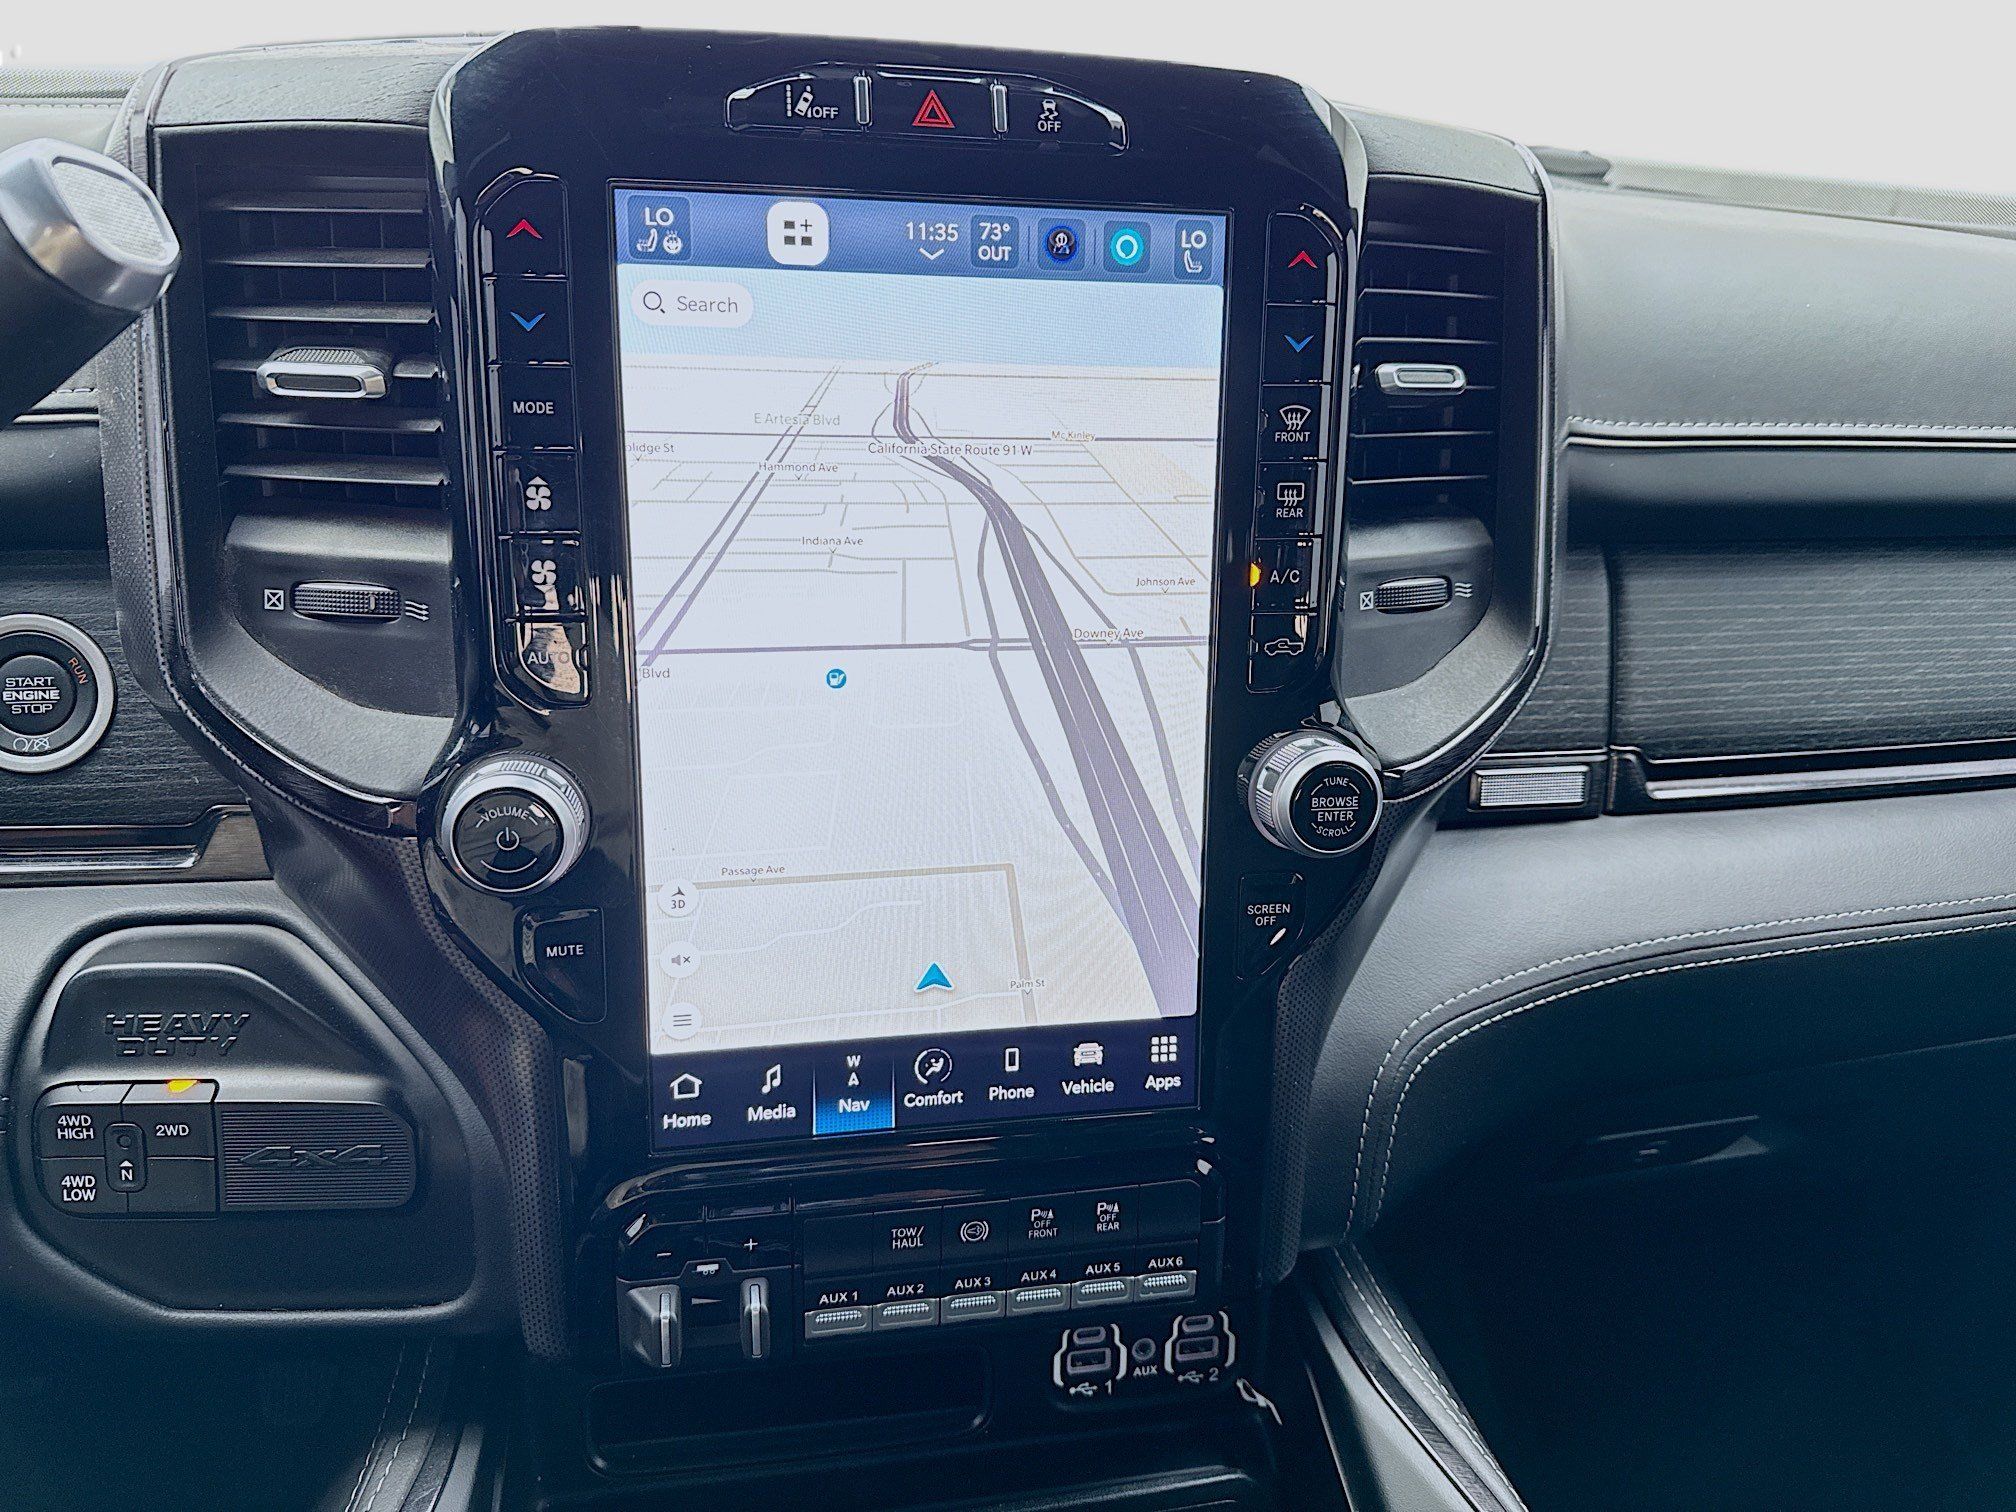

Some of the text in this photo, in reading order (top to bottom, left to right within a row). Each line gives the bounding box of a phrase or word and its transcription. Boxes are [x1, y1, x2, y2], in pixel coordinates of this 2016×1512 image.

[812, 106, 839, 119] OFF
[1037, 119, 1062, 132] OFF
[643, 207, 674, 227] LO
[905, 222, 959, 243] 11:35
[1181, 229, 1208, 249] LO
[978, 245, 1012, 262] OUT
[676, 295, 739, 315] Search
[512, 401, 555, 416] MODE
[754, 412, 841, 428] E Artesia Blvd
[1274, 430, 1311, 443] FRONT
[663, 442, 675, 453] St
[867, 441, 1033, 457] California State Route 91 W
[758, 460, 839, 473] Hammond Ave
[1275, 507, 1304, 520] REAR
[802, 534, 864, 547] Indiana Ave
[1136, 575, 1196, 588] Johnson Ave
[1269, 570, 1301, 585] A/C
[1074, 627, 1144, 641] Downey Ave
[68, 657, 89, 685] RUN
[642, 668, 671, 679] Blvd
[5, 676, 55, 687] START
[2, 690, 60, 700] ENGINE
[11, 704, 53, 714] STOP
[1323, 776, 1350, 788] TUNE
[1311, 795, 1359, 808] BROWSE
[481, 808, 530, 825] VOLUME
[1316, 809, 1354, 822] ENTER
[1316, 825, 1352, 838] SCROLL
[721, 863, 786, 878] Passage Ave
[670, 898, 686, 910] 3D
[1247, 904, 1291, 915] SCREEN
[1255, 916, 1277, 926] OFF
[546, 943, 585, 958] MUTE
[1010, 978, 1046, 989] Palm St
[106, 1013, 249, 1035] HEAVY
[115, 1037, 238, 1057] DUTY
[847, 1055, 861, 1068] W
[1062, 1078, 1114, 1095] Vehicle
[1145, 1073, 1181, 1093] Apps
[904, 1089, 963, 1108] Comfort
[989, 1083, 1034, 1102] Phone
[747, 1102, 796, 1121] Media
[838, 1097, 870, 1114] Nav
[57, 1115, 91, 1127] 4WD
[663, 1110, 711, 1129] Home
[57, 1127, 94, 1139] HIGH
[156, 1124, 189, 1137] 2WD
[122, 1168, 133, 1181] N
[61, 1176, 95, 1187] 4WD
[63, 1188, 96, 1201] LOW
[1034, 1220, 1051, 1229] OFF
[1099, 1214, 1117, 1223] OFF
[891, 1226, 924, 1239] TOW/
[1028, 1227, 1058, 1239] FRONT
[1097, 1221, 1120, 1232] REAR
[892, 1237, 923, 1249] HAUL
[1085, 1262, 1121, 1275] AUX 5
[1148, 1256, 1184, 1269] AUX 6
[1021, 1269, 1057, 1282] AUX 4
[954, 1277, 991, 1290] AUX 3
[886, 1284, 924, 1297] AUX 2
[819, 1292, 858, 1304] AUX 1
[1133, 1365, 1158, 1377] AUX
[1208, 1367, 1219, 1382] 2
[1105, 1379, 1113, 1396] 1
